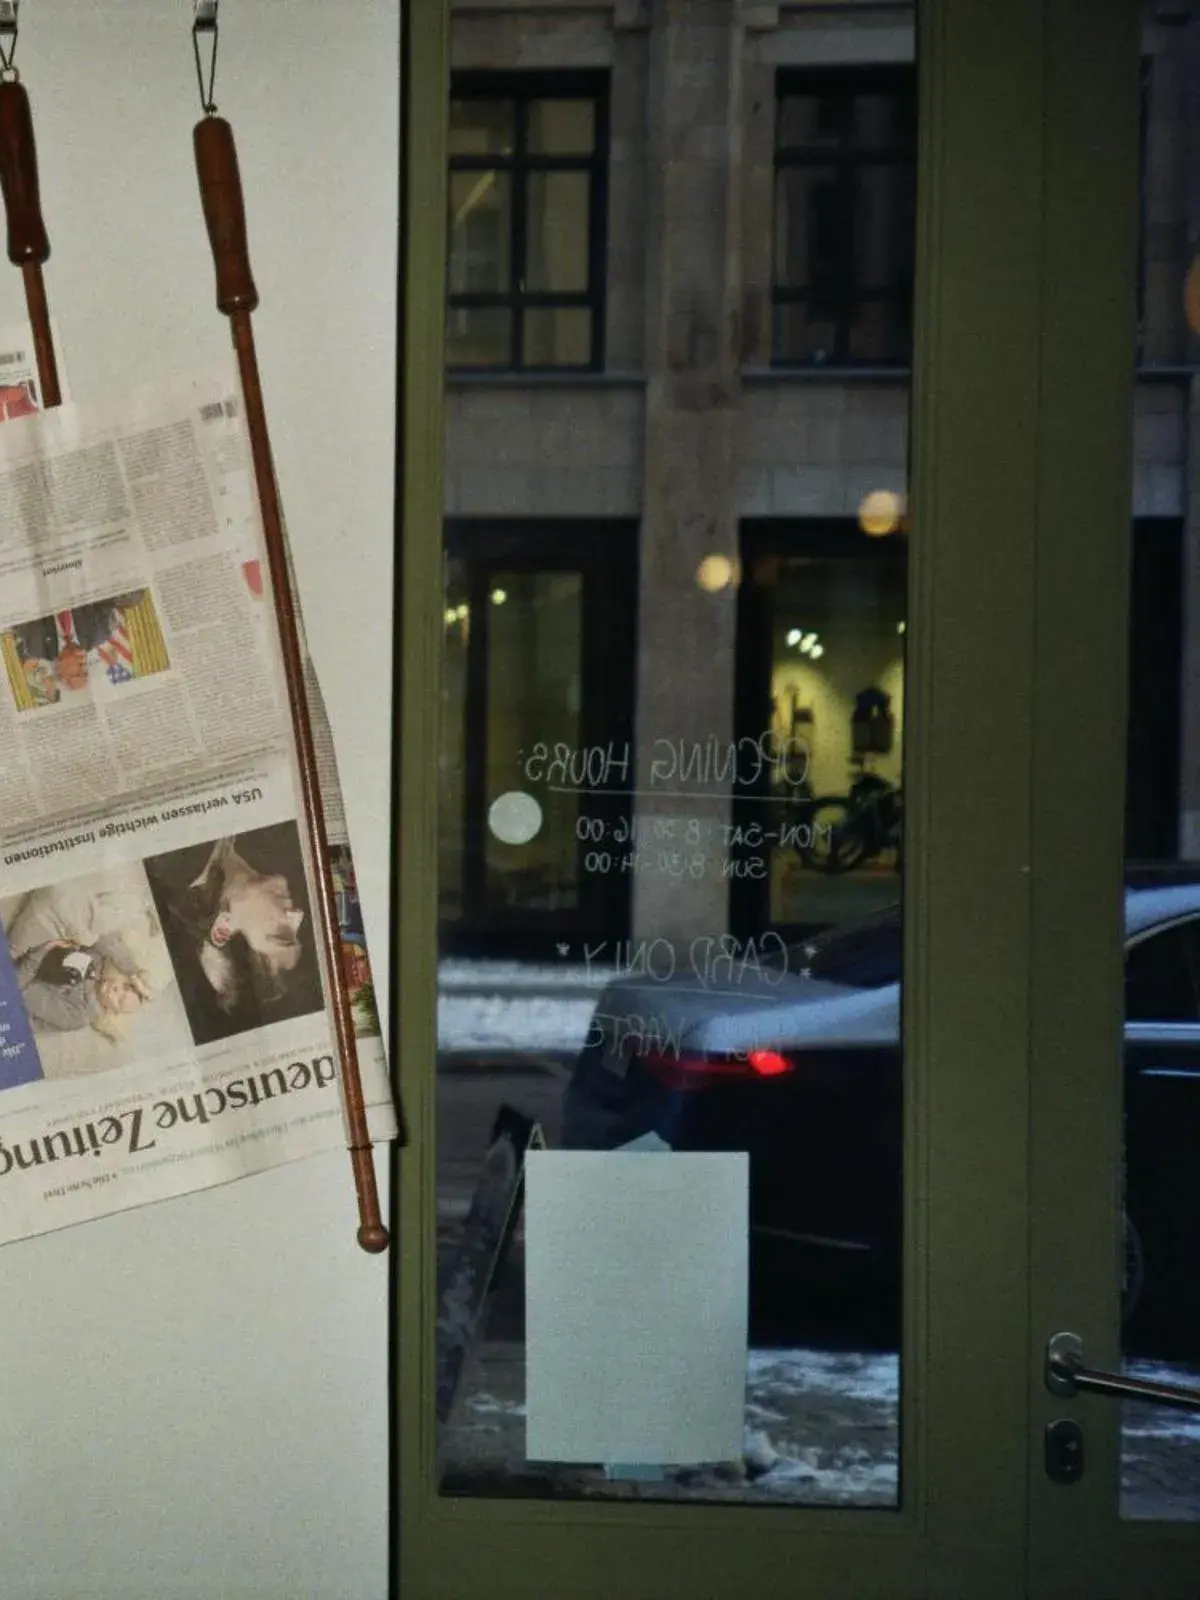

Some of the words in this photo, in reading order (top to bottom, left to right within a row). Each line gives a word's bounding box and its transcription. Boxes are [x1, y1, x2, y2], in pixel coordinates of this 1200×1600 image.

[230, 787, 263, 804] USA
[160, 796, 229, 822] verlassen
[97, 815, 159, 839] wichtige
[3, 831, 96, 867] Institutionen
[152, 1055, 336, 1125] deutsche
